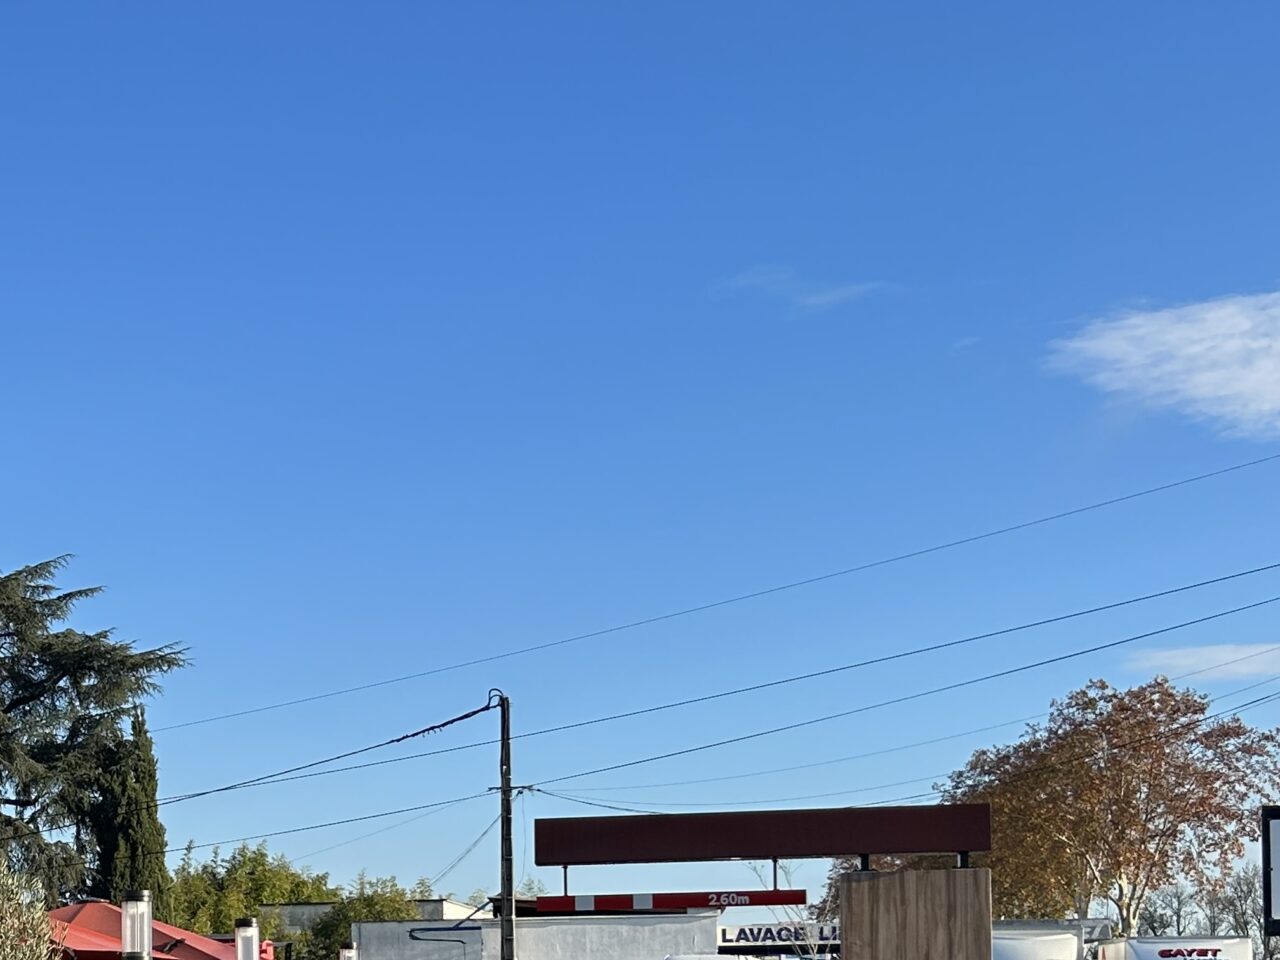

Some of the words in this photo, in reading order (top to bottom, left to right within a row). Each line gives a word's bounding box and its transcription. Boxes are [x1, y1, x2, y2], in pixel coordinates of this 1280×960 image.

[708, 893, 749, 905] 2.60m
[721, 926, 805, 943] LAVAGE
[1158, 948, 1222, 959] GAYET
